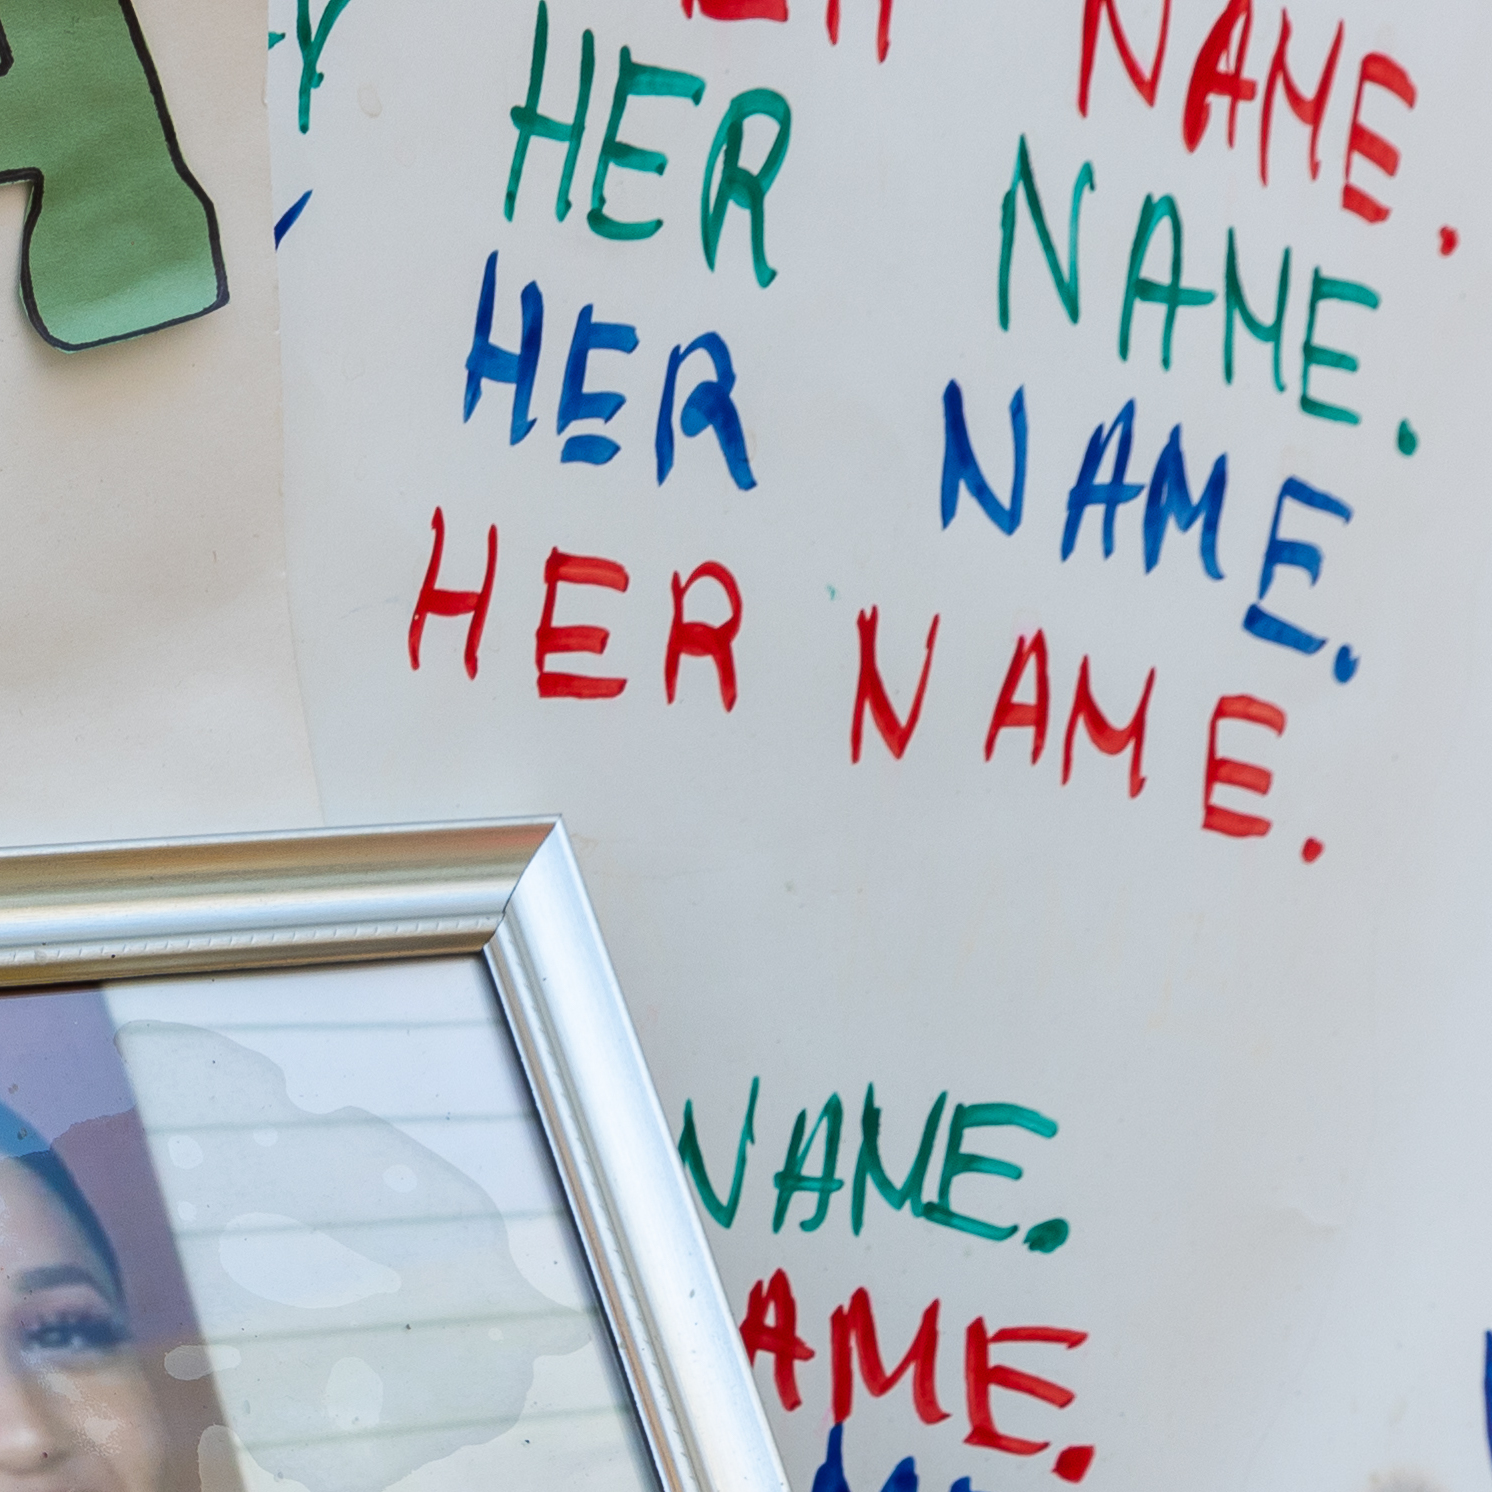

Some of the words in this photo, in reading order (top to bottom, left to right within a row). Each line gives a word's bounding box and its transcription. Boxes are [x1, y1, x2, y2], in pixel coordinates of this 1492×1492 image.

[504, 0, 793, 289] HER
[998, 132, 1419, 457] NAME.
[1078, 0, 1459, 258] NAME.
[463, 250, 758, 491] HER
[941, 379, 1360, 684] NAME.
[408, 506, 745, 713] HER
[850, 605, 1327, 864] NAME.
[740, 1268, 1097, 1484] AME.
